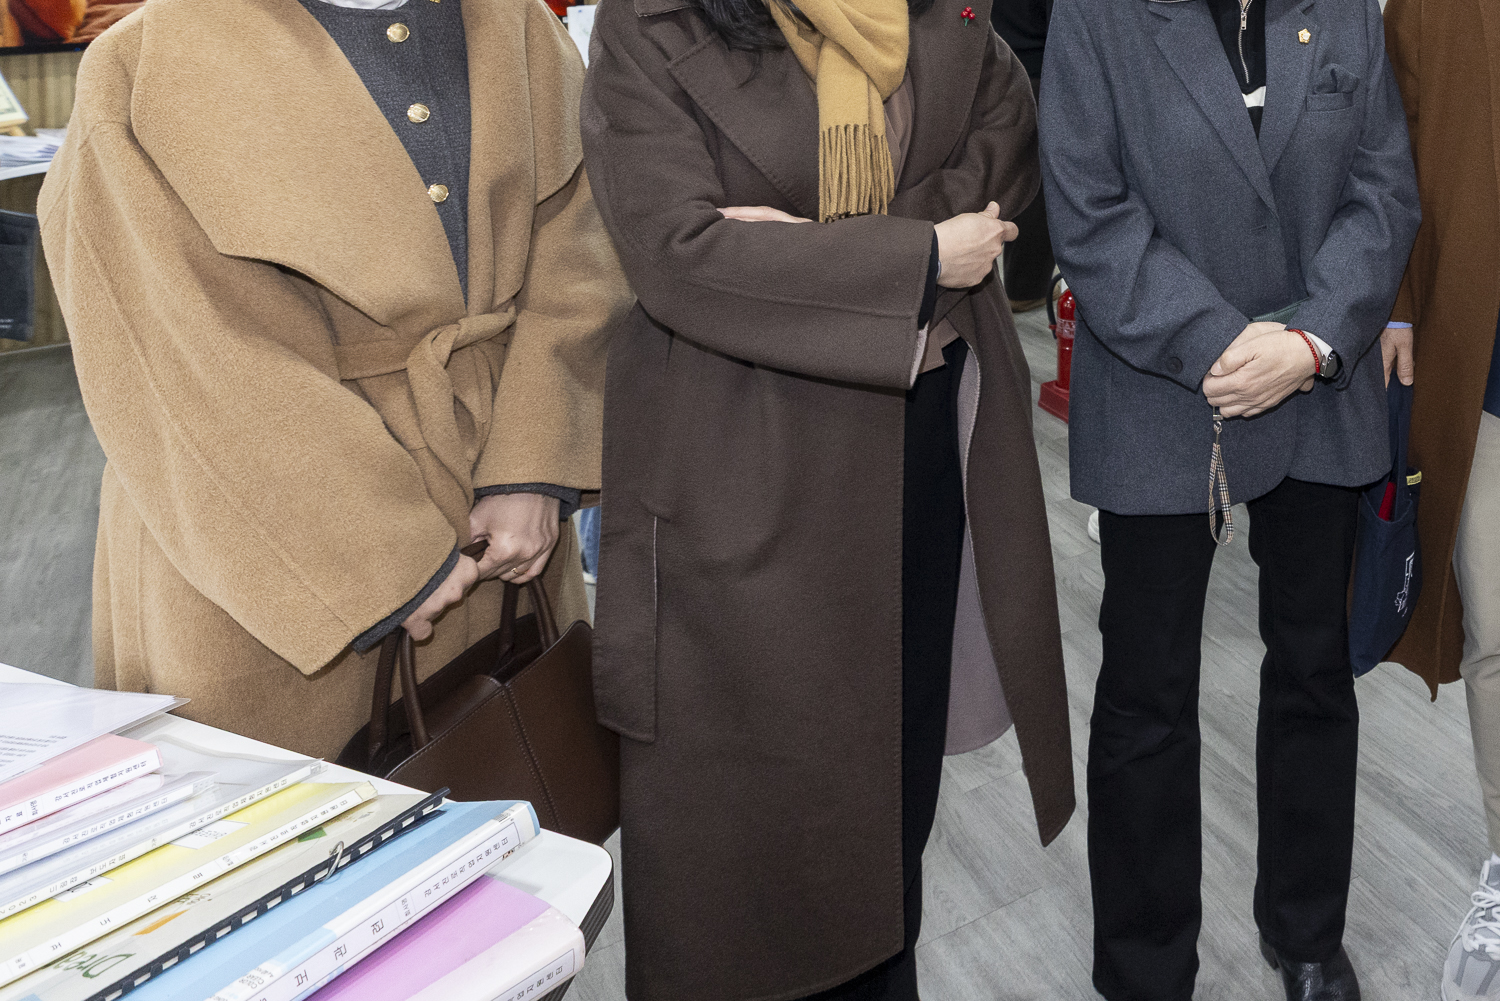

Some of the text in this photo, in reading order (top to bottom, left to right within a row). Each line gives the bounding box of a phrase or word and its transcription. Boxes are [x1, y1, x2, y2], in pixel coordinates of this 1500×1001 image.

[55, 760, 148, 802] 강서진로직업체험지원센터
[189, 777, 288, 829] 강서진로직업체험지원센터
[89, 854, 127, 875] 보도자료
[424, 837, 509, 898] 강서진로직업지원센터
[53, 951, 136, 978] Drea
[505, 966, 564, 1001] 업지원센터
